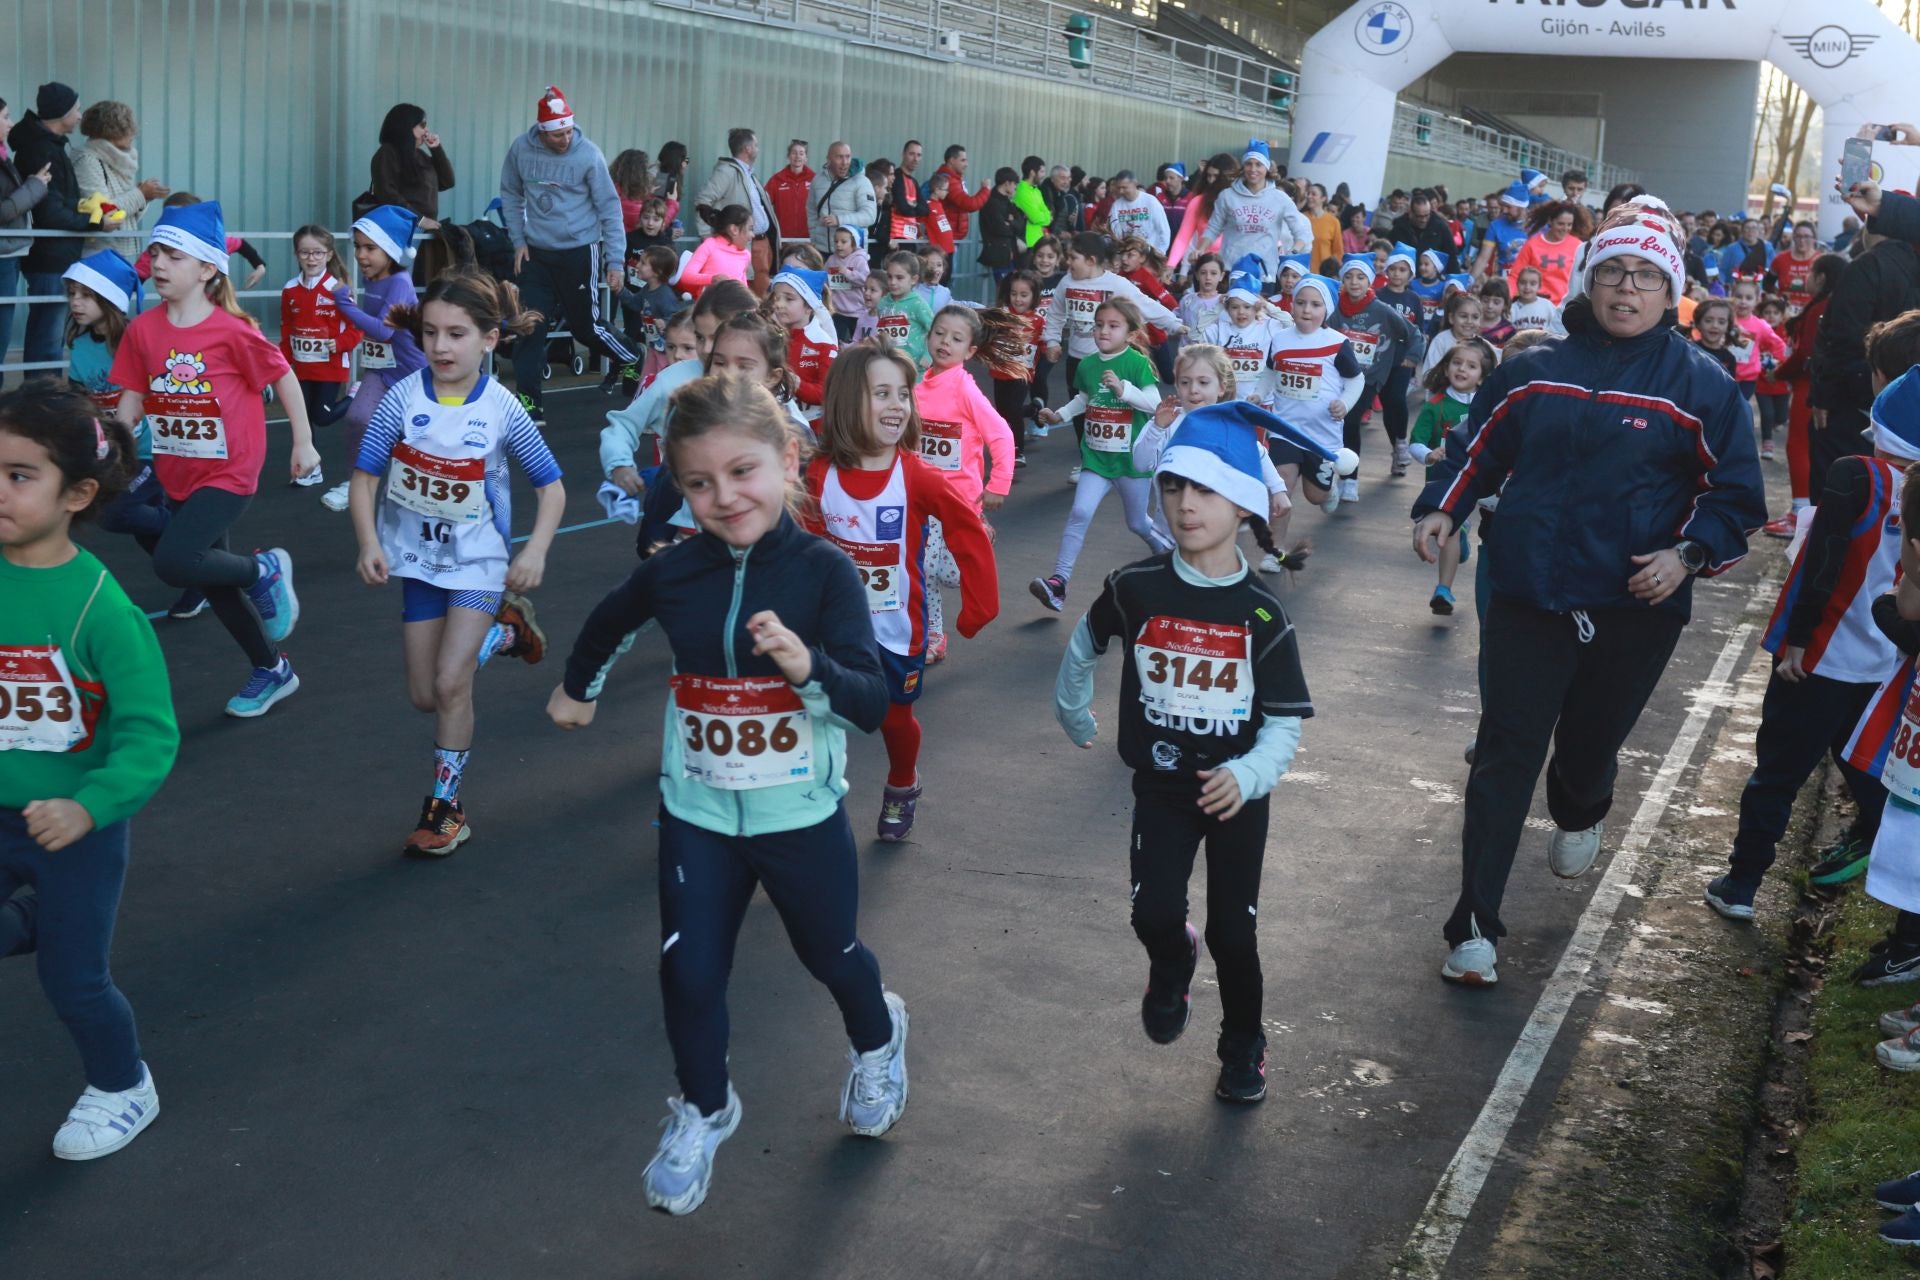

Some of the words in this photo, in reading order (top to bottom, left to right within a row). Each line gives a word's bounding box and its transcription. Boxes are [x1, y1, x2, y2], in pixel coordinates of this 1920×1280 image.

[1541, 18, 1589, 37] Gijón
[1608, 20, 1666, 38] Avilés
[1813, 41, 1847, 53] MINI
[1247, 214, 1259, 224] 76
[1596, 237, 1640, 254] Snow
[1640, 235, 1668, 257] for
[1068, 300, 1095, 313] 3163
[1281, 374, 1312, 390] 3151
[156, 417, 218, 441] 3423
[1086, 421, 1126, 440] 3084
[401, 467, 471, 504] 3139
[1159, 619, 1170, 629] 37
[1174, 622, 1208, 635] Carrera
[1209, 627, 1243, 639] Popular
[1192, 635, 1204, 644] de
[1165, 640, 1226, 658] Nochebuena
[1146, 651, 1239, 693] 3144
[705, 680, 743, 691] Carrera
[744, 680, 786, 692] Popular
[726, 694, 741, 702] de
[702, 702, 768, 715] Nochebuena
[685, 714, 799, 757] 3086
